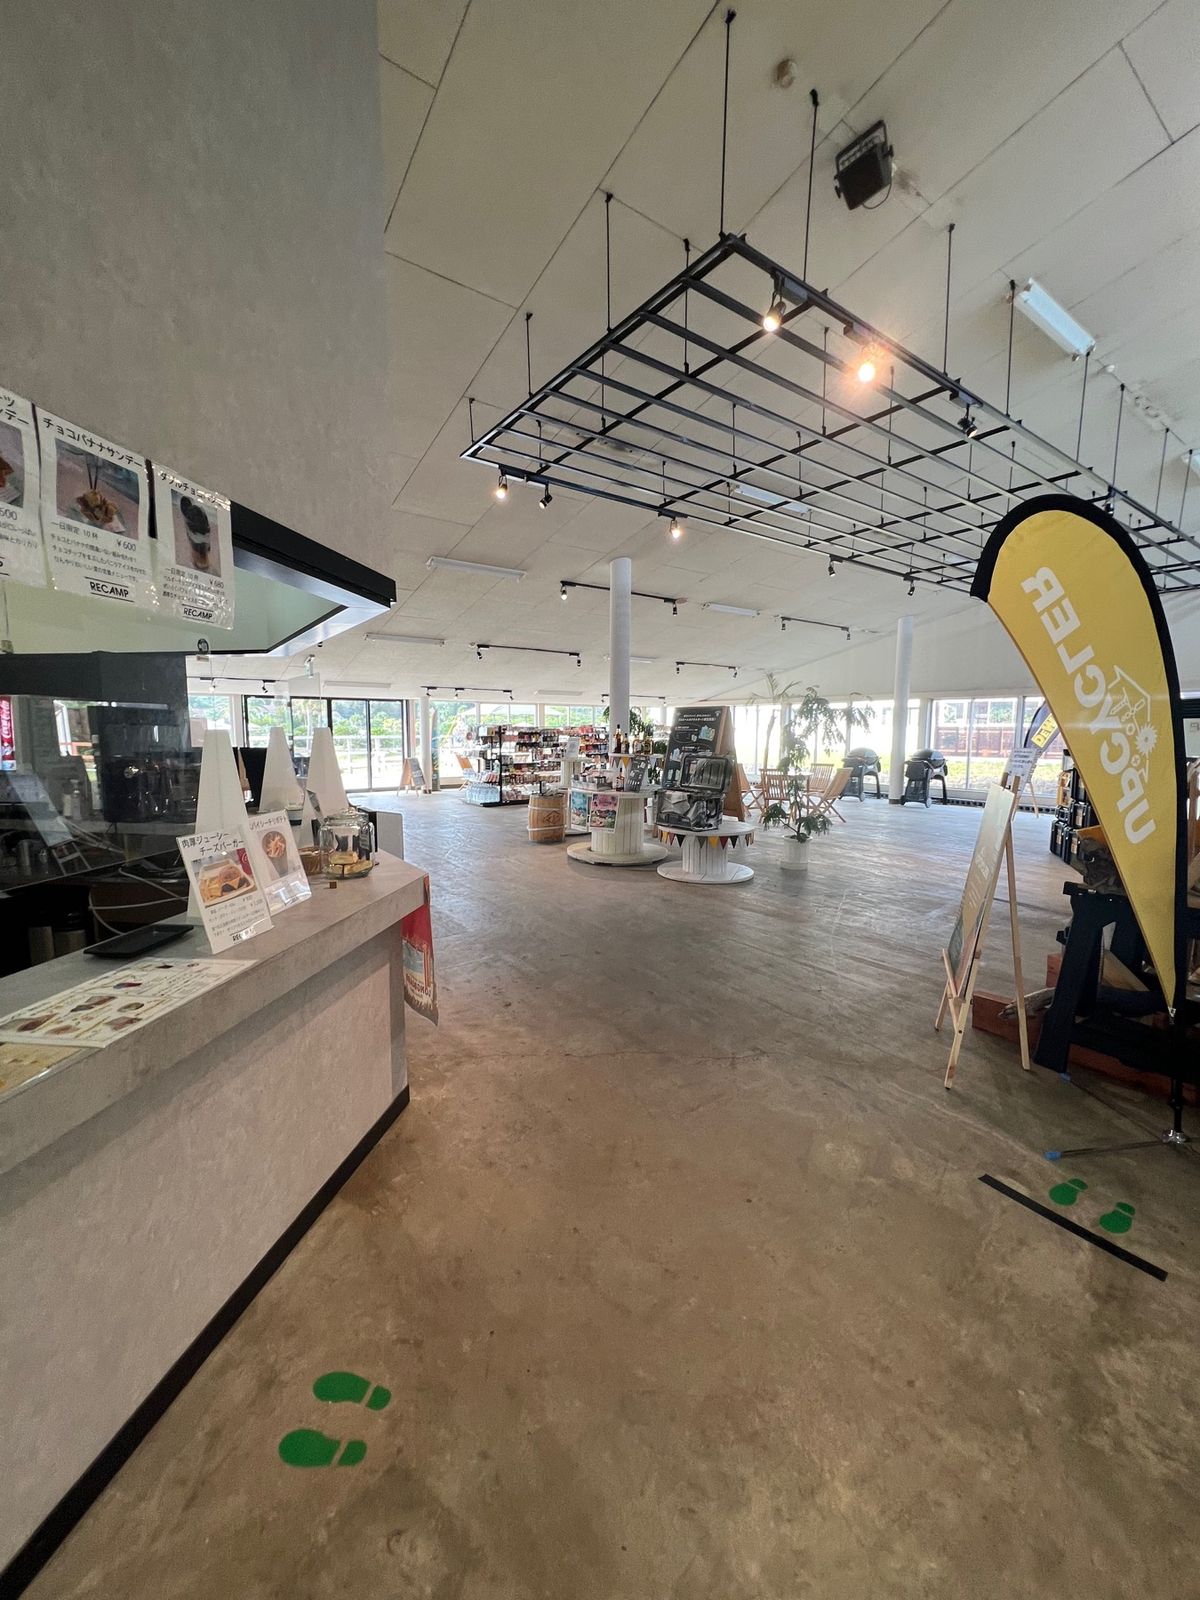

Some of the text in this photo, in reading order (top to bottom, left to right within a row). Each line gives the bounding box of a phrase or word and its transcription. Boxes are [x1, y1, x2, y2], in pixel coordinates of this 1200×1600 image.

[43, 417, 143, 468] チョコバナナサンデー
[90, 581, 129, 598] RECAMP
[183, 607, 213, 620] RECAMP
[199, 839, 245, 856] チーズバーガー
